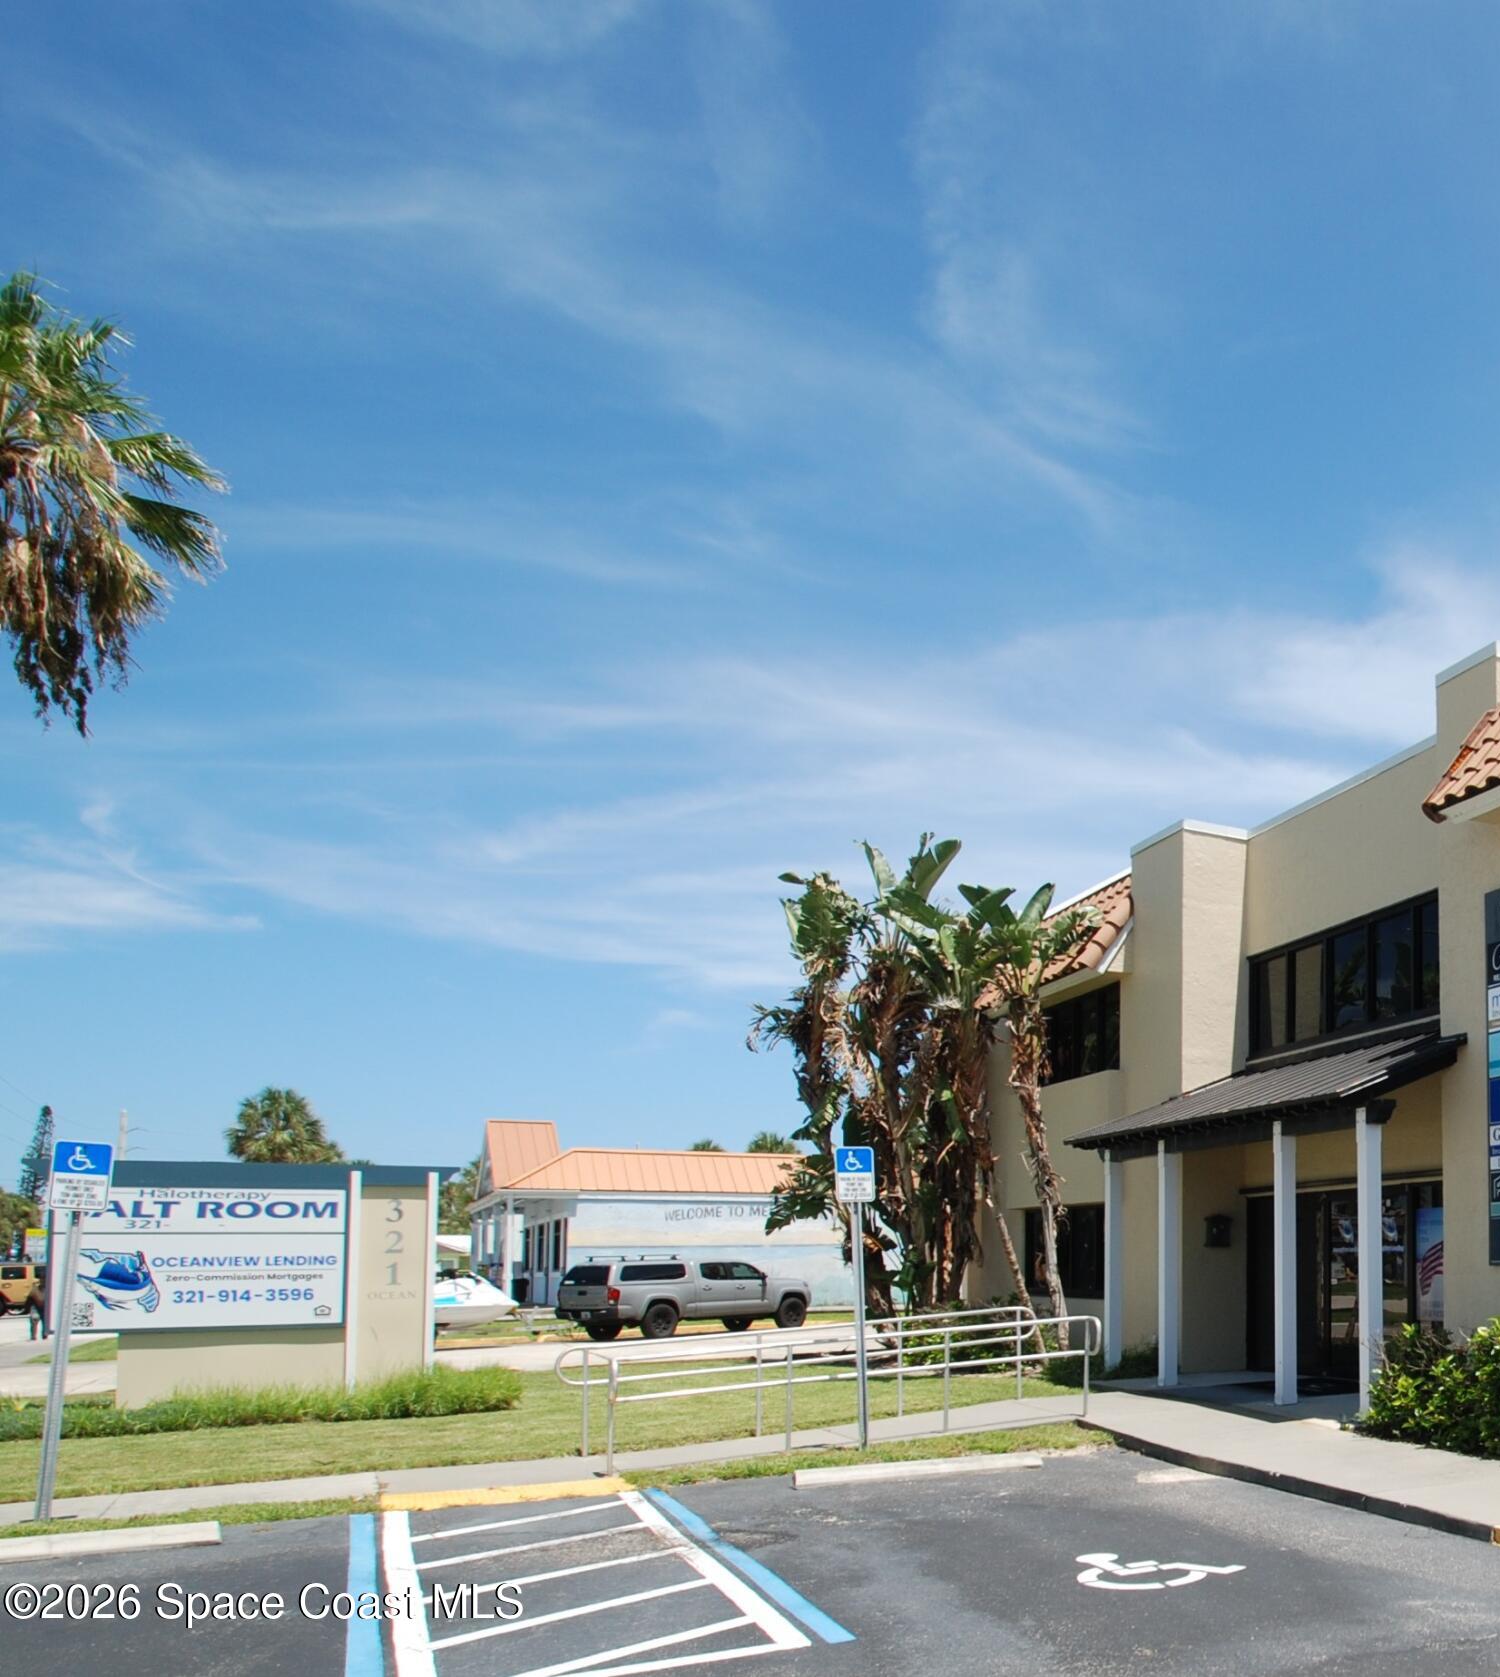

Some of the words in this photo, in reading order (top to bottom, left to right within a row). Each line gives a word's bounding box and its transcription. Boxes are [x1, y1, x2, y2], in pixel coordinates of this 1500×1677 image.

[84, 1200, 180, 1218] ALT
[197, 1201, 338, 1218] ROOM
[664, 1206, 722, 1222] WELCOME
[728, 1206, 744, 1217] TO
[152, 1256, 261, 1267] OCEANVIEW
[265, 1255, 337, 1266] LENDING
[165, 1273, 265, 1282] Zero-Commission
[267, 1272, 324, 1282] Mortgages
[173, 1288, 315, 1303] 321-914-3596
[367, 1290, 417, 1301] OCEAN
